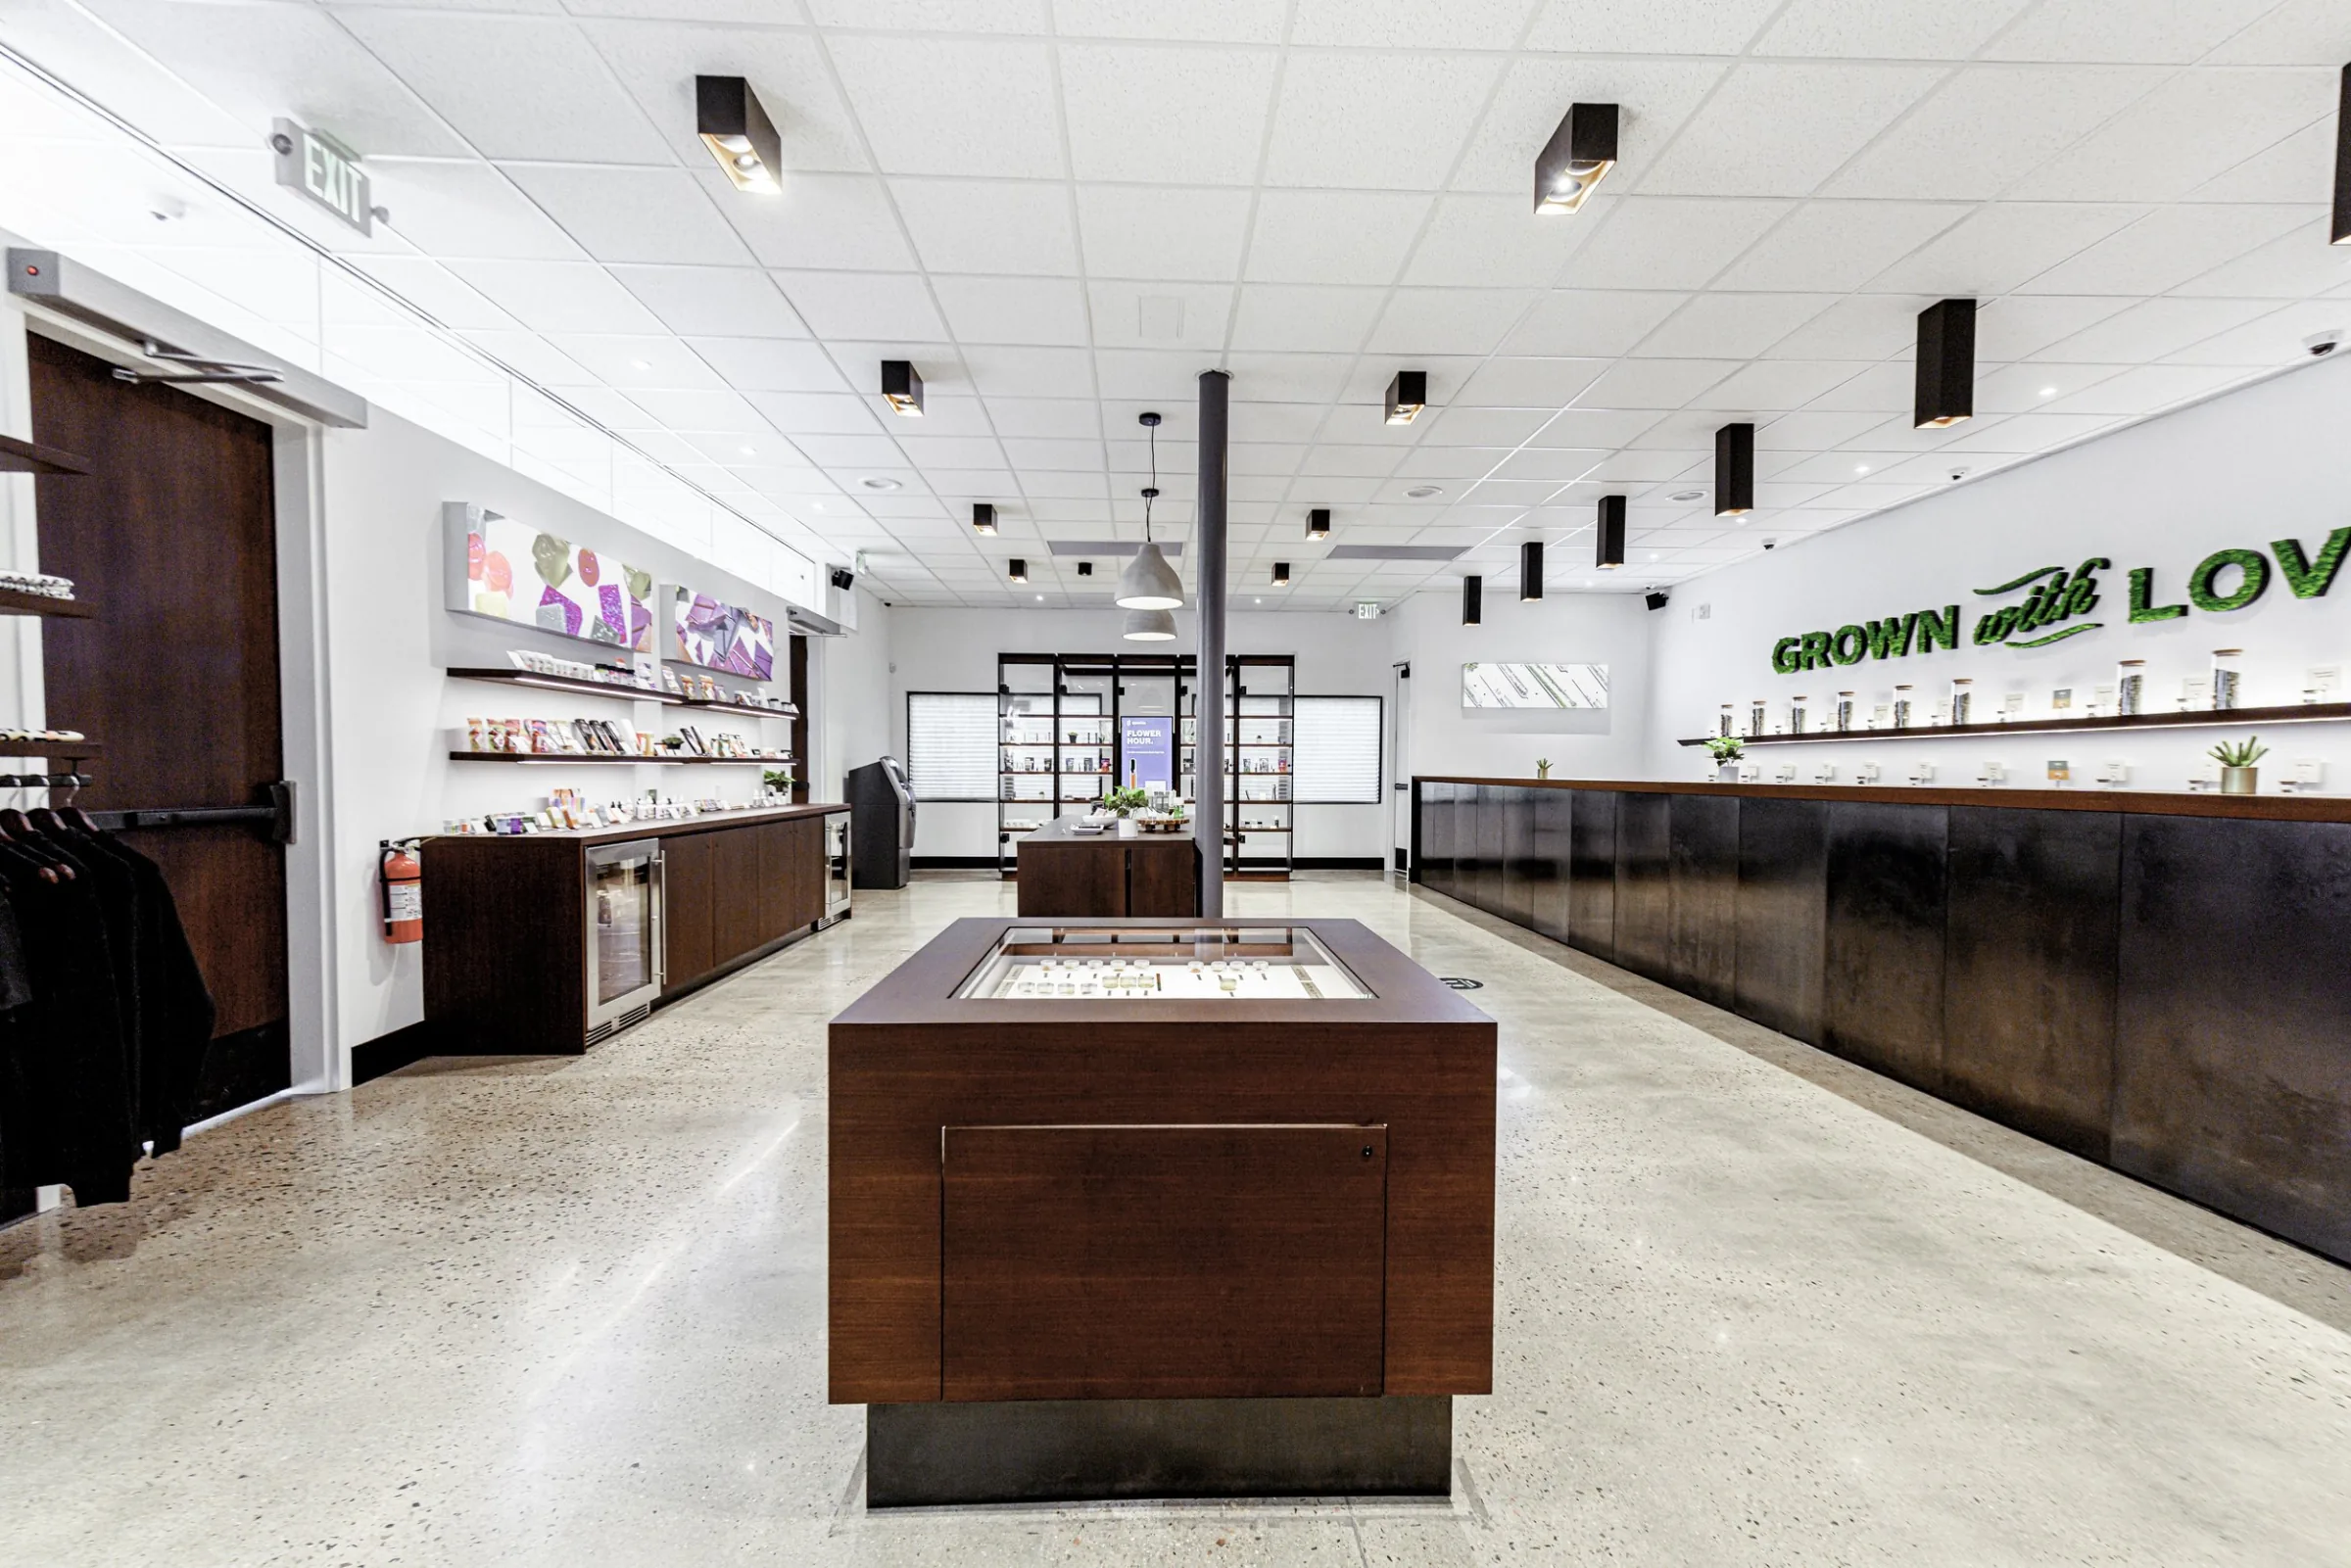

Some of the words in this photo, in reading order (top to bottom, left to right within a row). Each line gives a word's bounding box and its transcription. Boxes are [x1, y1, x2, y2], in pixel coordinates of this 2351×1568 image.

[303, 133, 362, 223] EXIT
[1358, 603, 1377, 620] EXIT
[1771, 605, 1961, 675] GROWN
[1972, 557, 2112, 646] with
